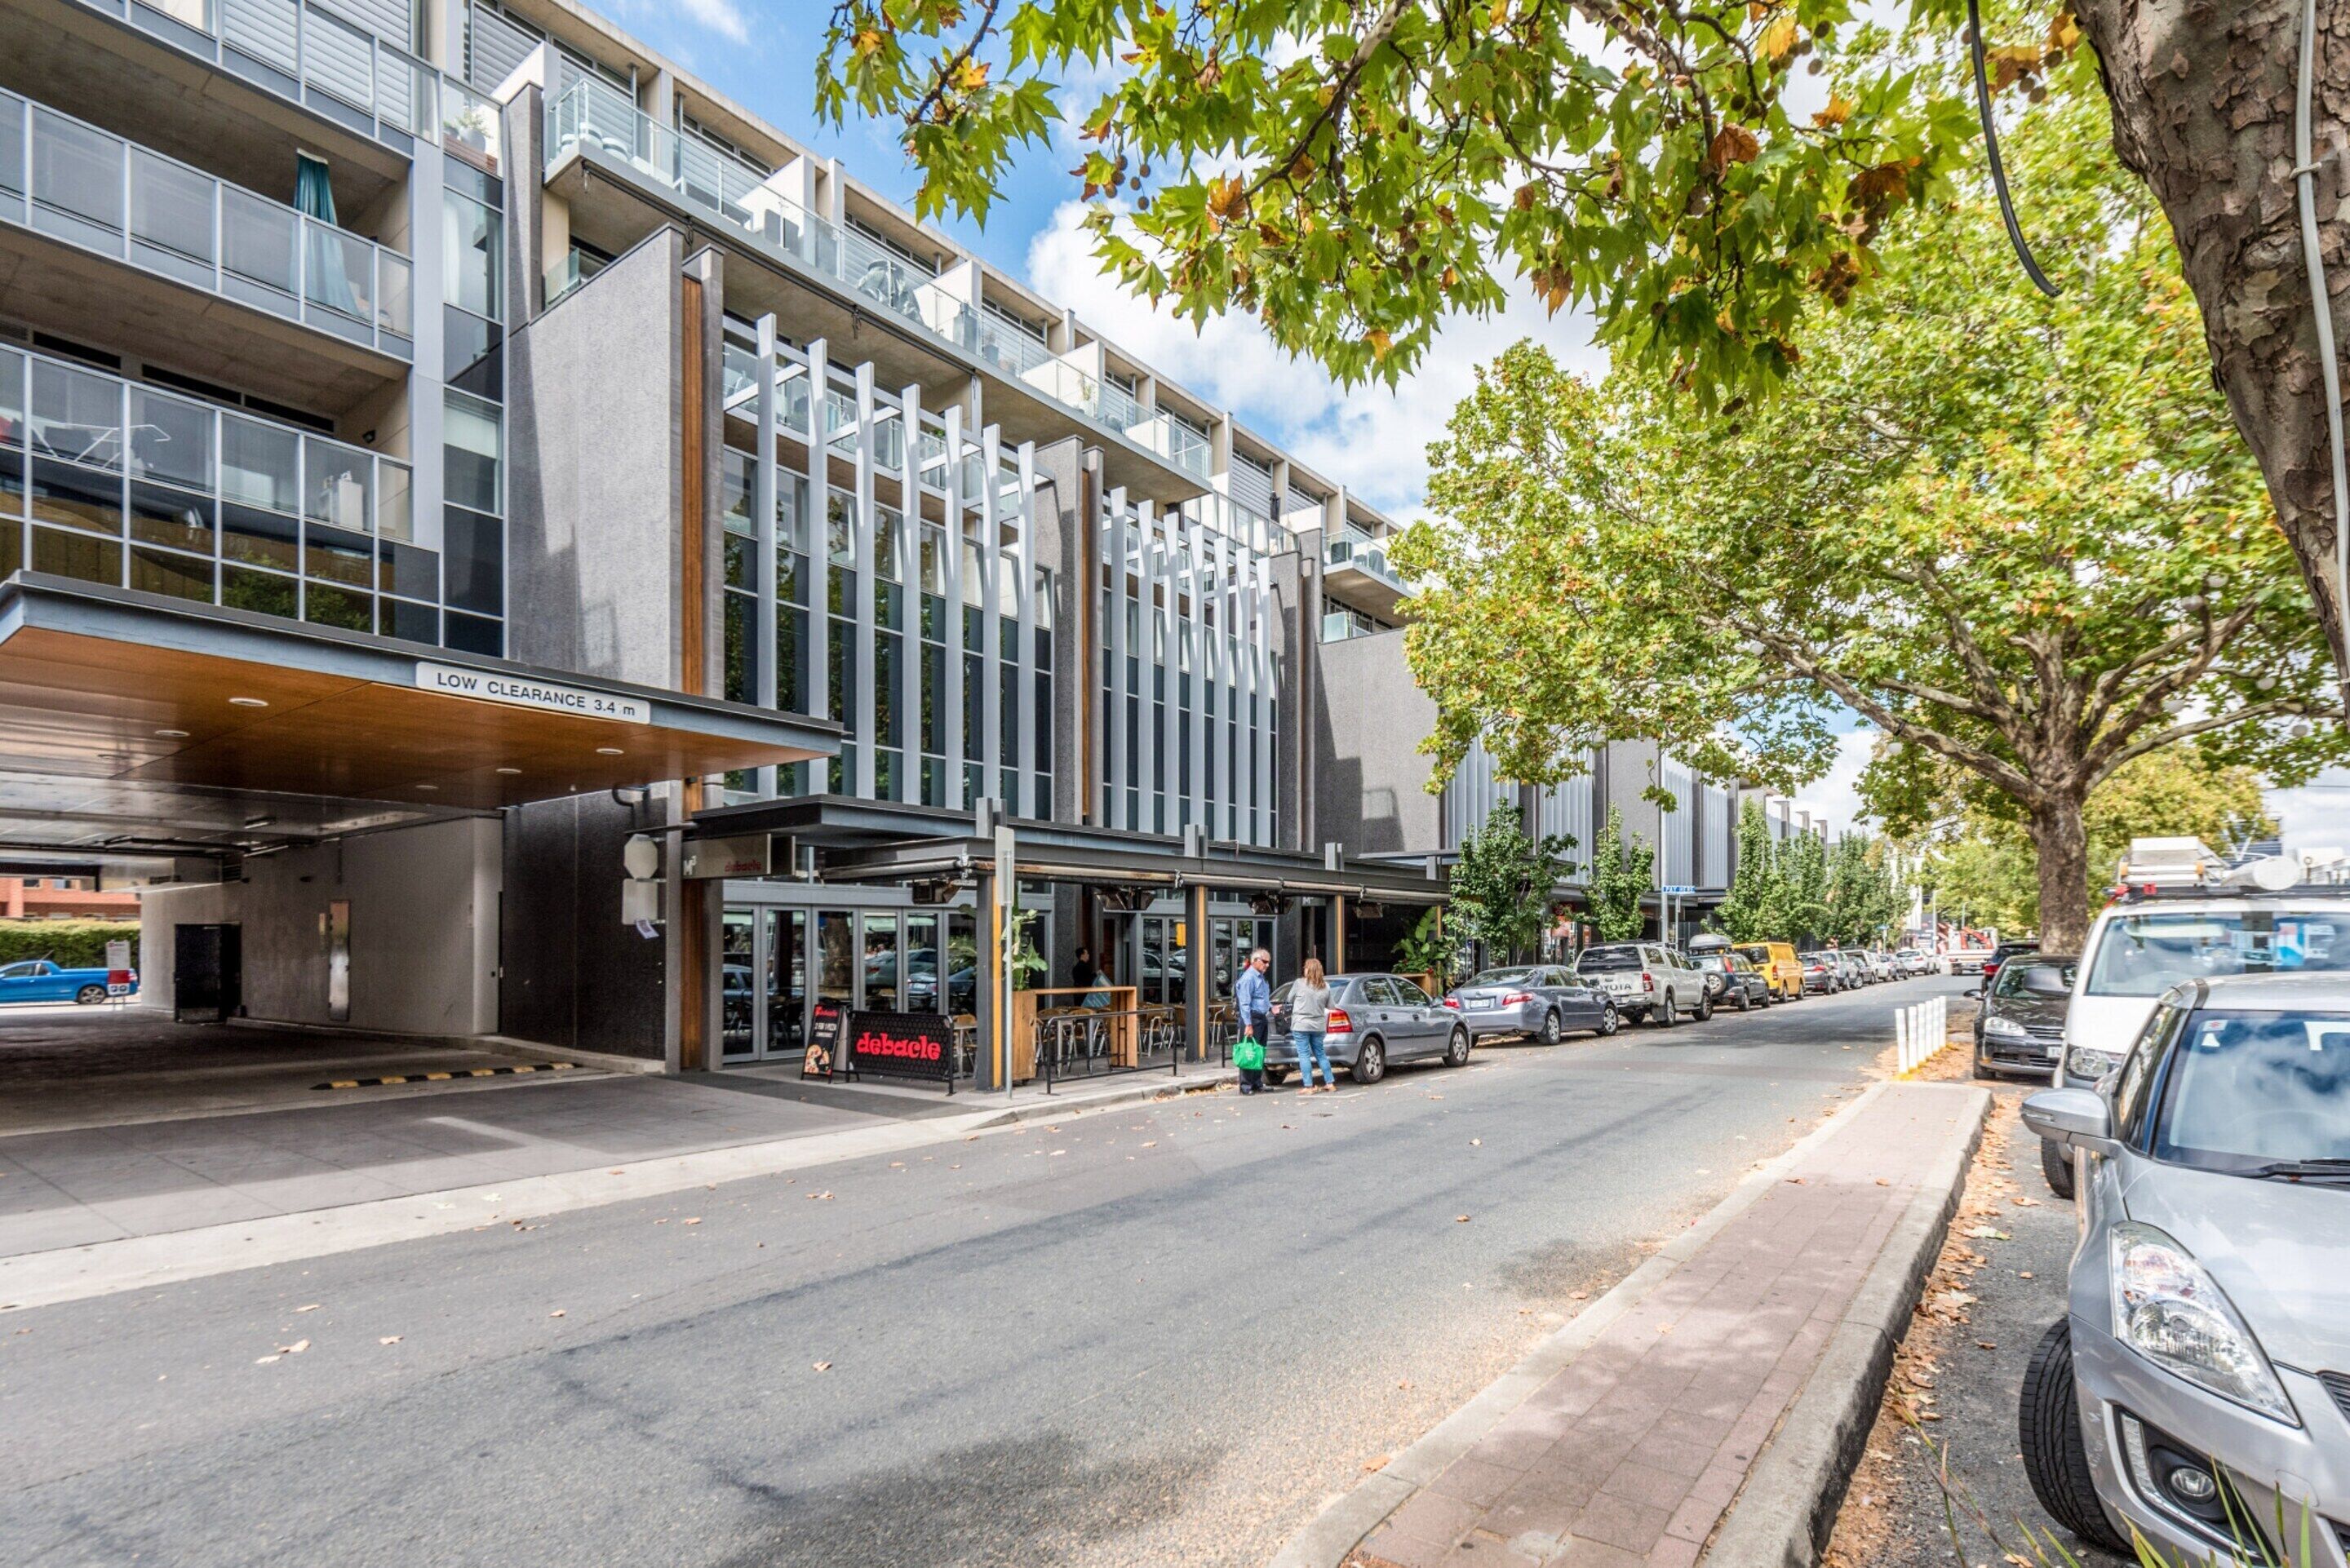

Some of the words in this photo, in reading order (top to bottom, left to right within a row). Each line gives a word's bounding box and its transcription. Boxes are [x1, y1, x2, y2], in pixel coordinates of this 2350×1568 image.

[437, 672, 477, 690] LOW
[488, 681, 586, 708] CLEARANCE
[594, 699, 615, 714] 3.4
[623, 706, 636, 715] m
[856, 1031, 942, 1061] debacle
